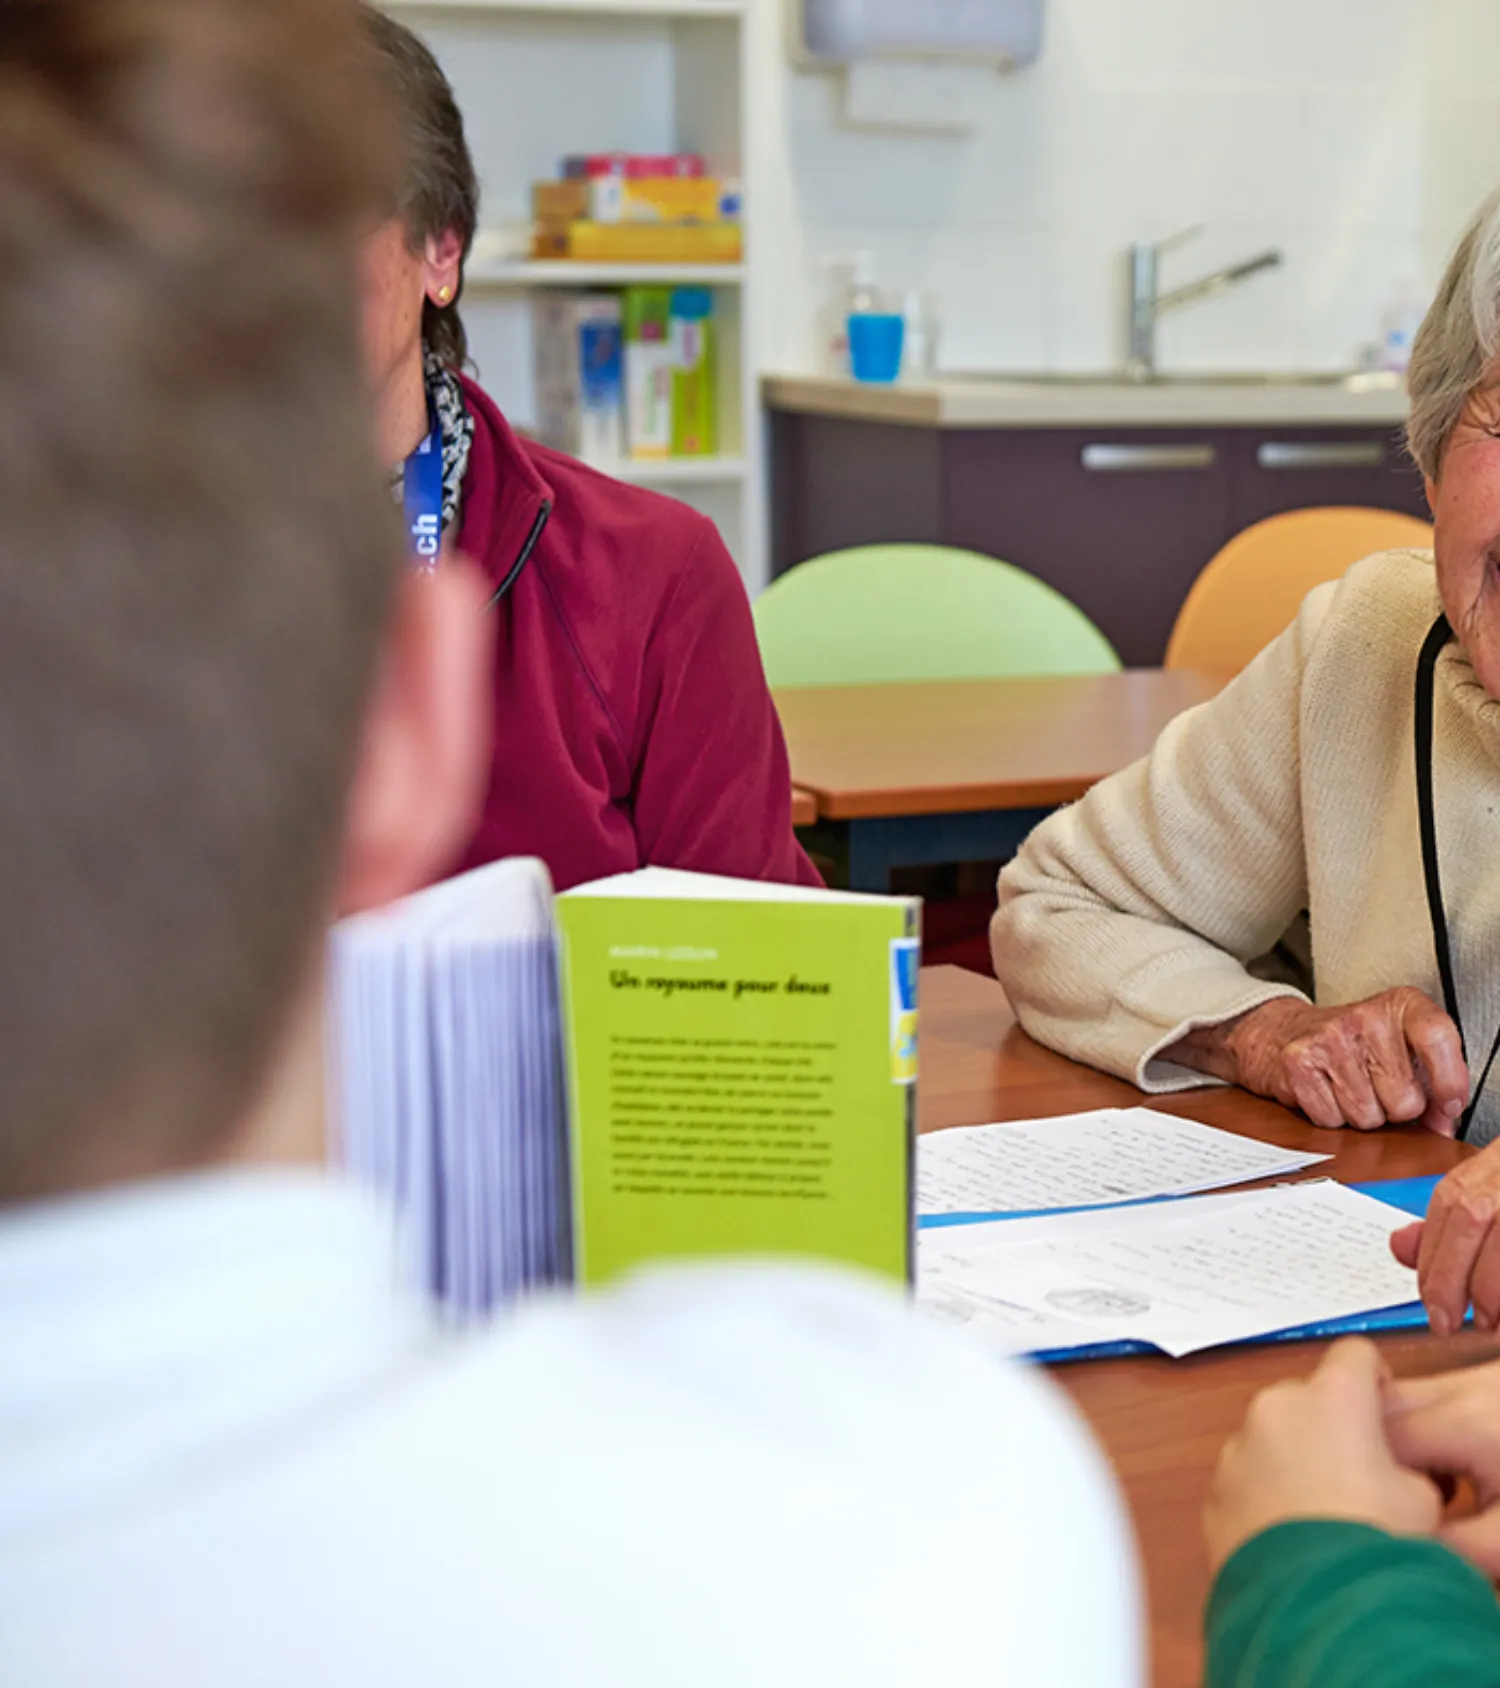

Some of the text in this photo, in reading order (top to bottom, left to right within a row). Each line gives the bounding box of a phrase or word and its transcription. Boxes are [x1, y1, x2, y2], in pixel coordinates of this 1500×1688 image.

[609, 969, 831, 1001] Un royaume pour deux
